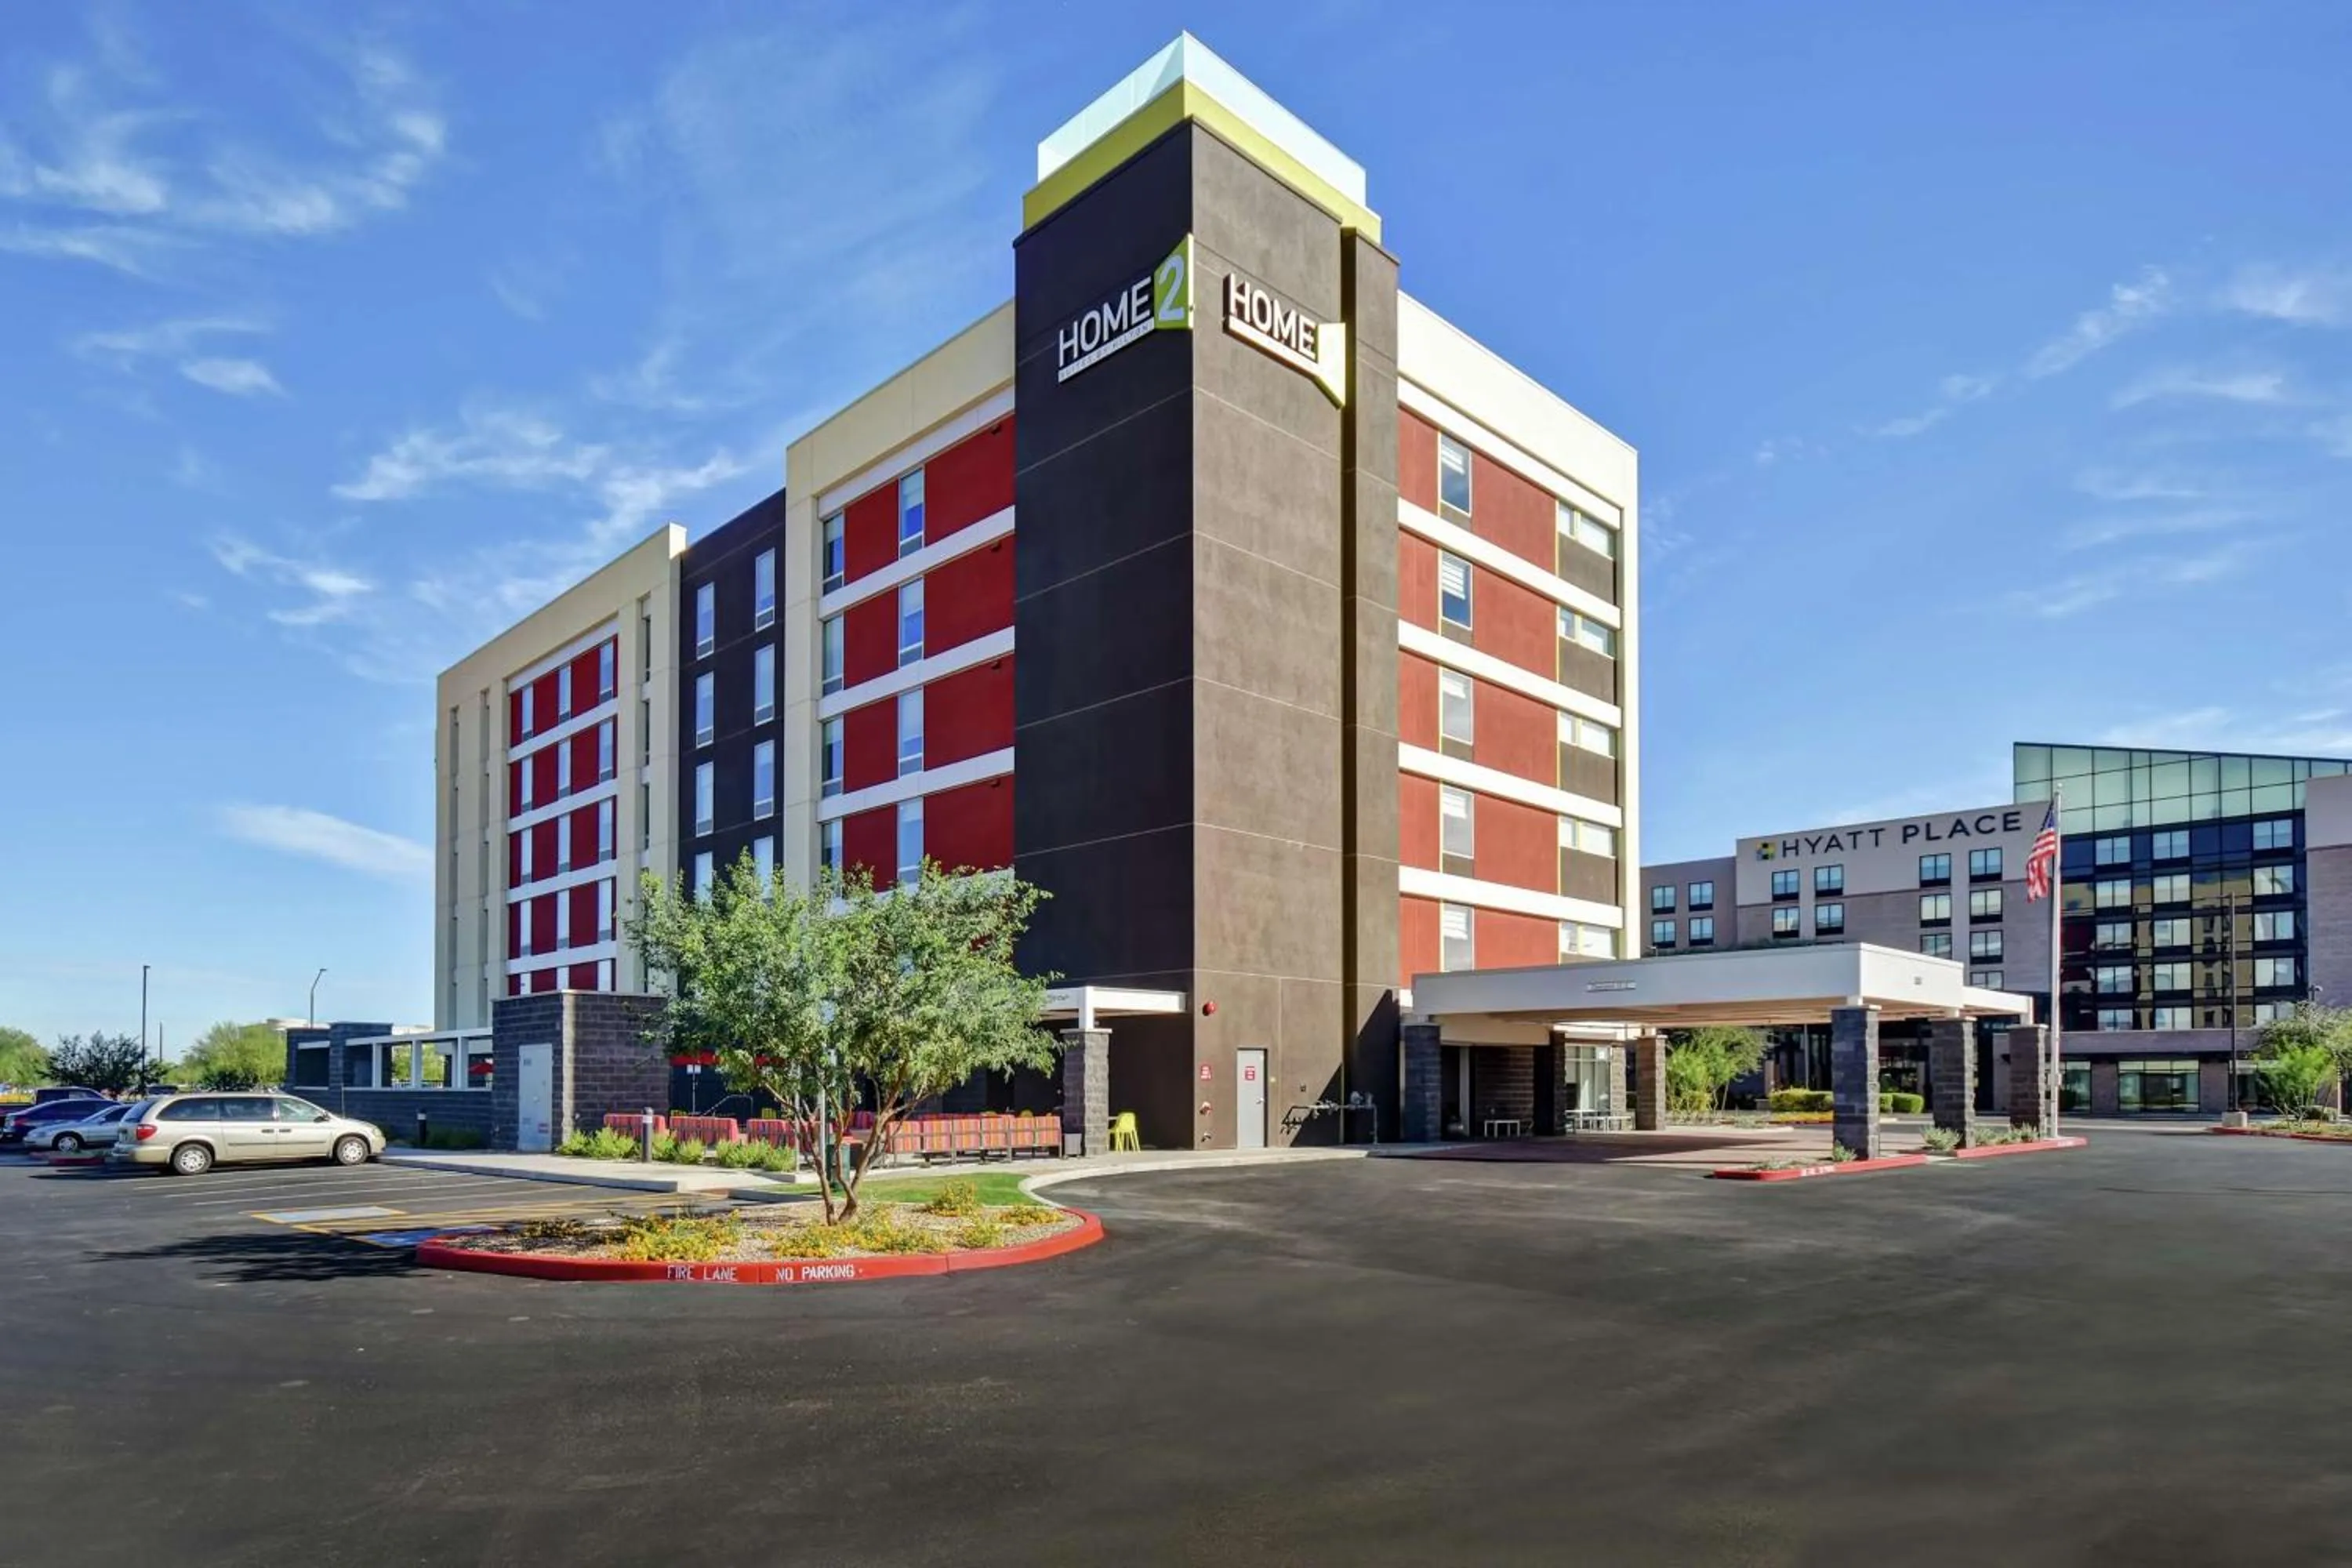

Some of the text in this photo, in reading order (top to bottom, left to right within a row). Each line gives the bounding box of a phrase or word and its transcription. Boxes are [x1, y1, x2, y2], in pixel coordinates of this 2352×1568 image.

[1229, 273, 1317, 360] HOME
[1781, 811, 2021, 858] HYATT PLACE
[667, 1264, 855, 1281] FIRE LANE NO PARKING
